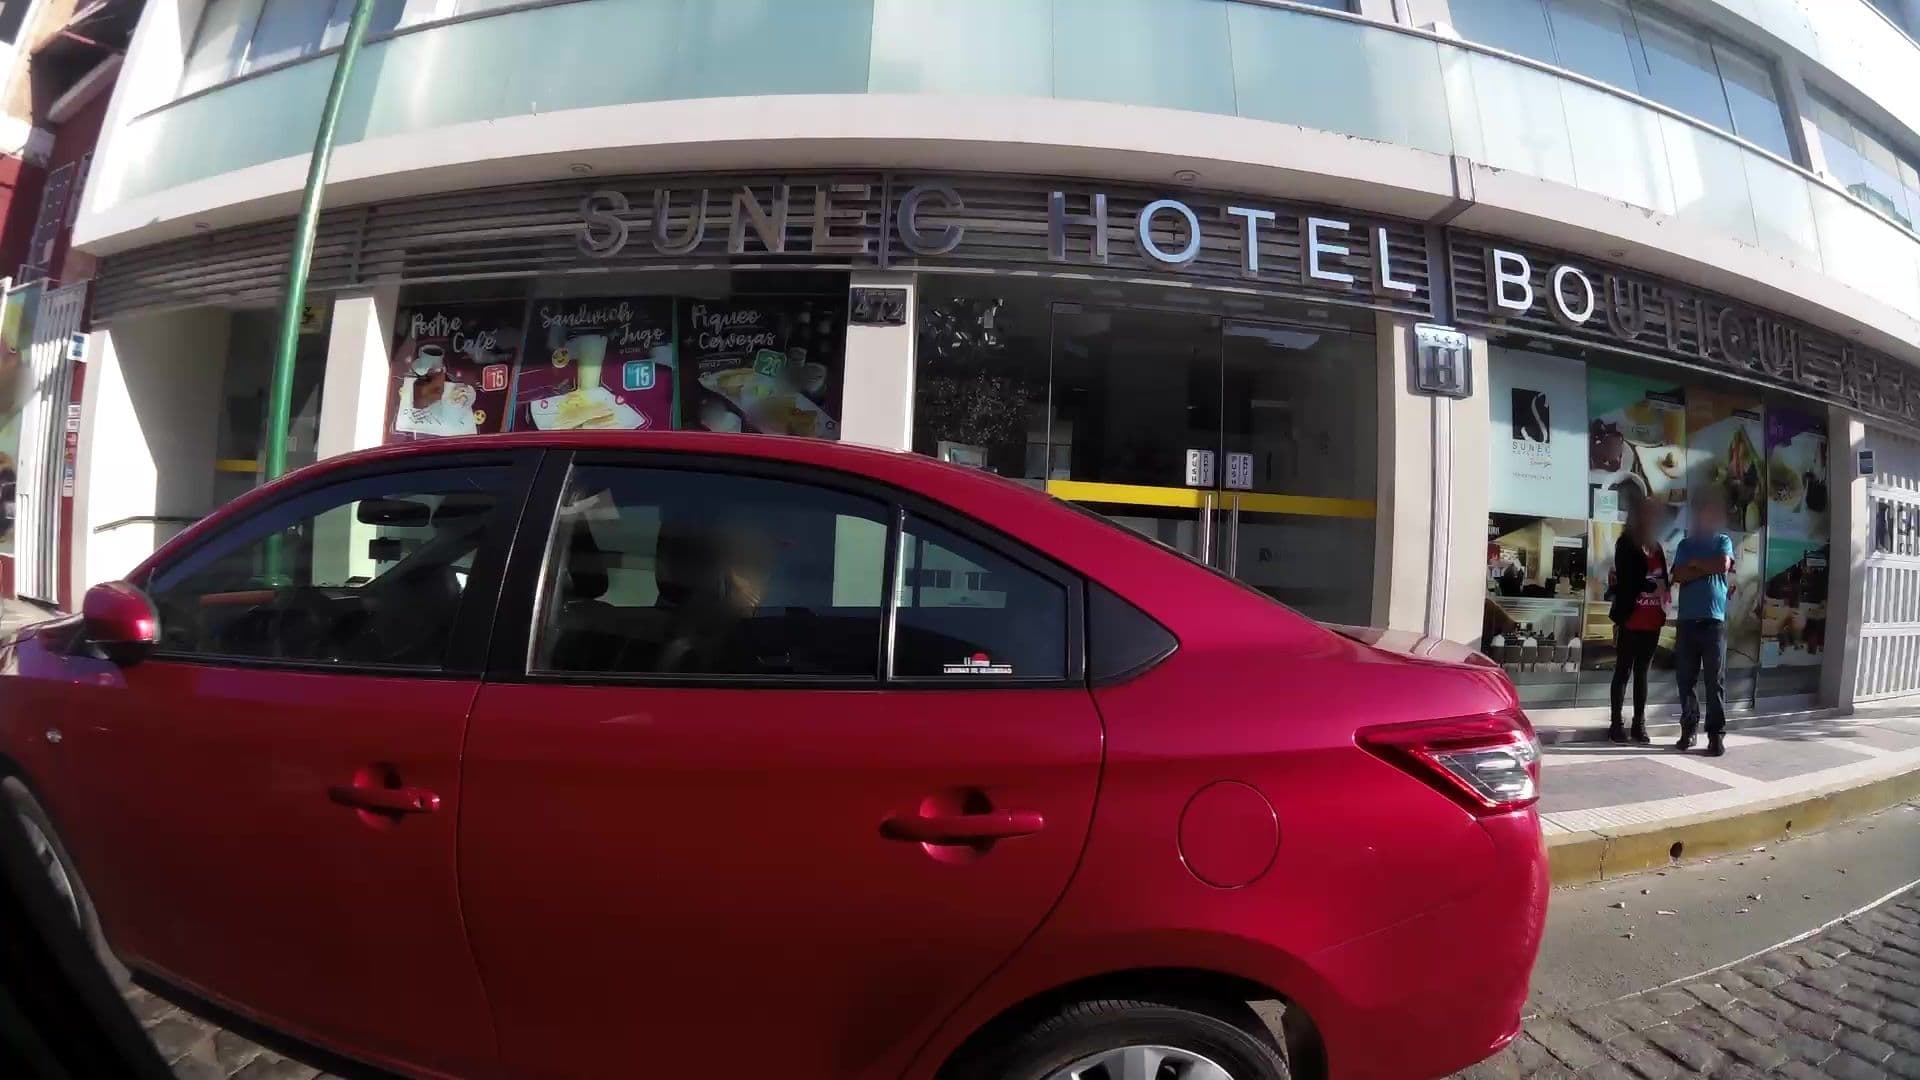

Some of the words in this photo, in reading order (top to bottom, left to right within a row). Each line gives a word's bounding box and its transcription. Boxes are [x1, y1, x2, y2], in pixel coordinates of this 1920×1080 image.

[575, 183, 965, 258] SUNEC
[1048, 191, 1416, 297] HOTEL
[411, 311, 463, 339] Postre
[540, 302, 634, 328] Sandwich
[452, 329, 498, 357] Café
[619, 322, 665, 348] Jugo
[698, 331, 777, 352] Cervezas
[634, 366, 650, 387] 15
